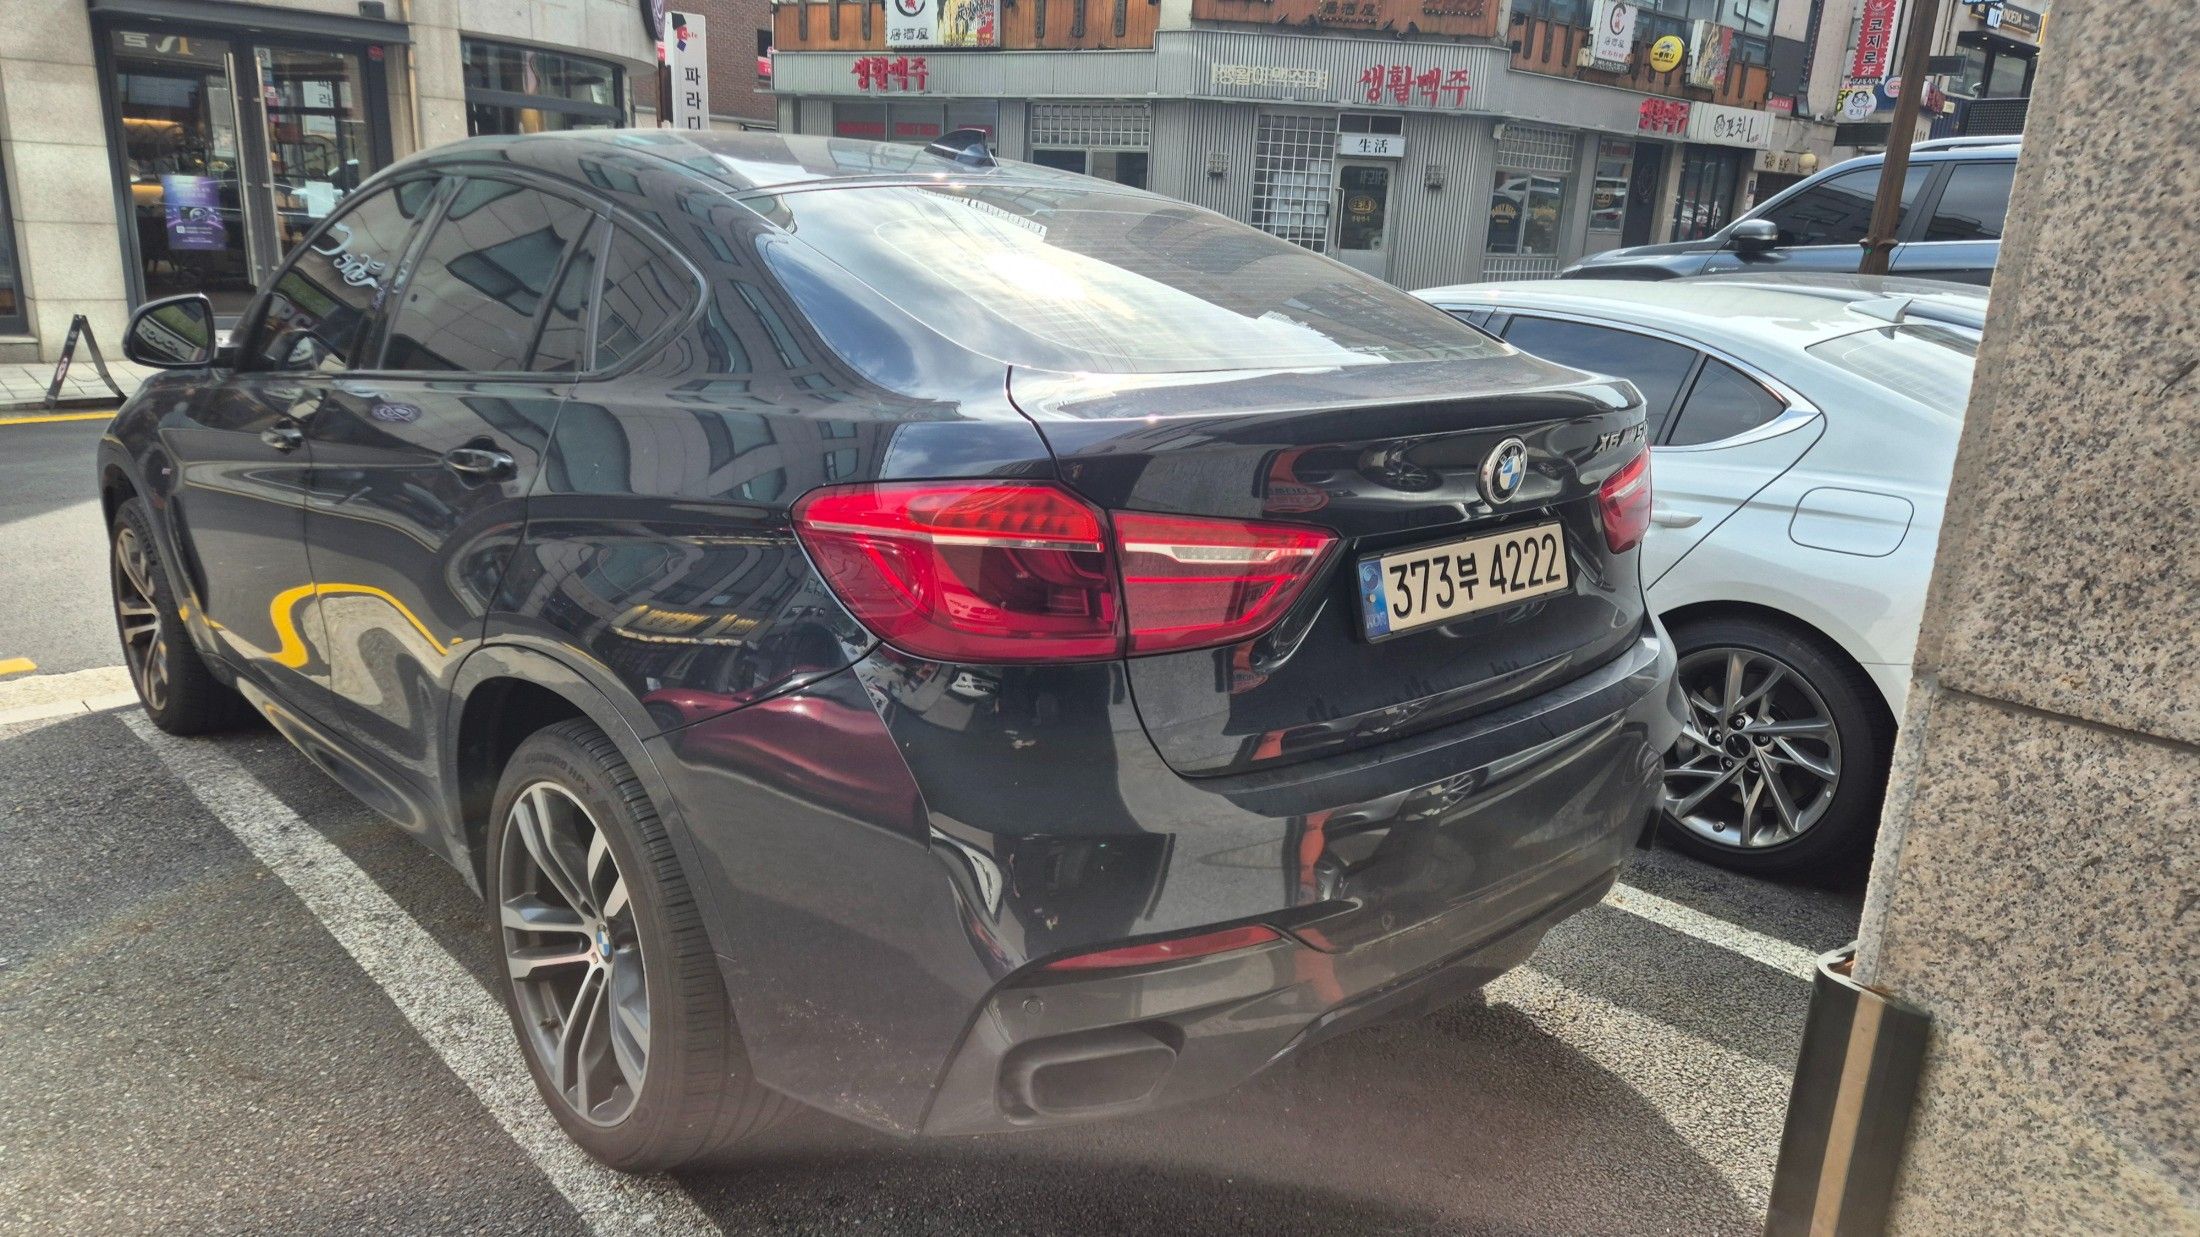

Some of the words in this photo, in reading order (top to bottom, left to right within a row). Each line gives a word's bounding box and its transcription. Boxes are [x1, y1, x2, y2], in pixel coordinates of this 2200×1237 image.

[1863, 18, 1884, 65] 코지로
[851, 56, 930, 93] 생활맥주
[1357, 64, 1471, 107] 생활맥주
[1861, 66, 1876, 76] 2F
[1358, 138, 1388, 153] 生活
[1389, 552, 1480, 619] 373부
[1489, 533, 1561, 595] 4222
